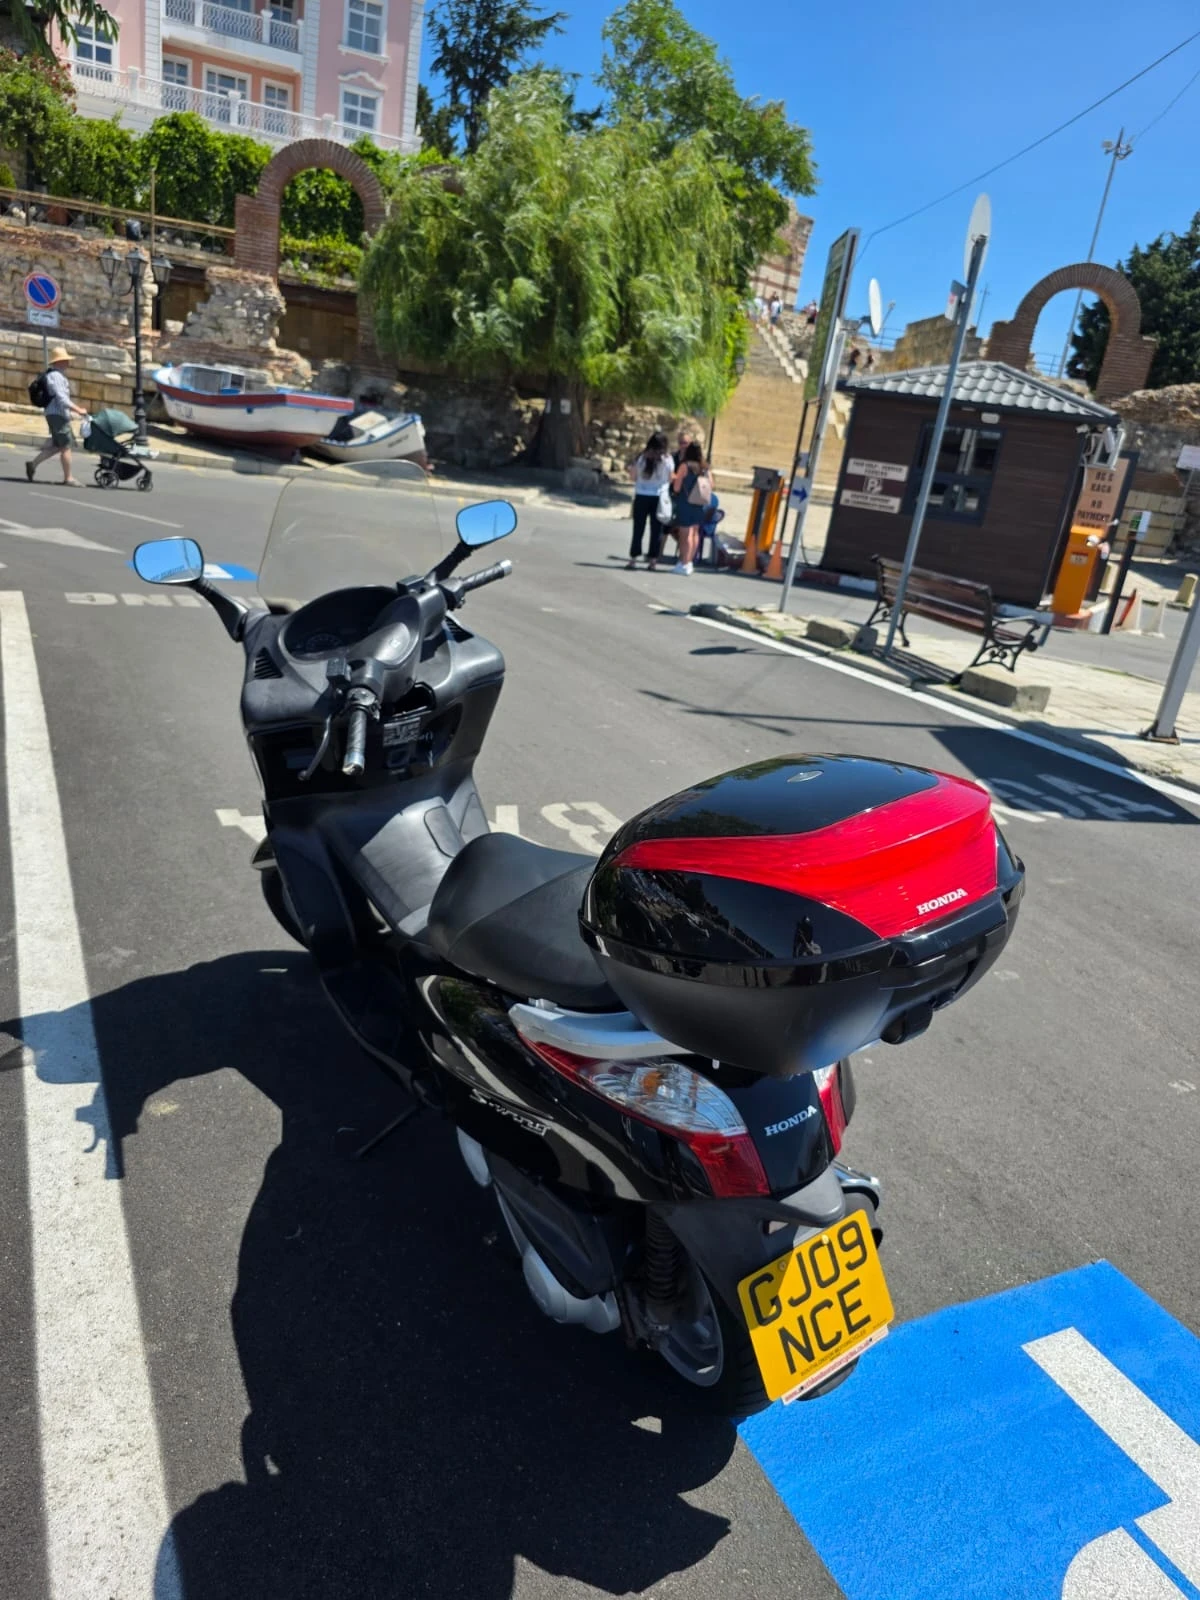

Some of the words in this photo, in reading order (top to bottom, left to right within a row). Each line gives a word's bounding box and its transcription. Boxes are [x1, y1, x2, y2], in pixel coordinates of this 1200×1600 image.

[916, 888, 968, 915] HONDA
[764, 1105, 817, 1136] HONDA
[748, 1220, 867, 1327] GJ09
[778, 1278, 871, 1375] NCE
